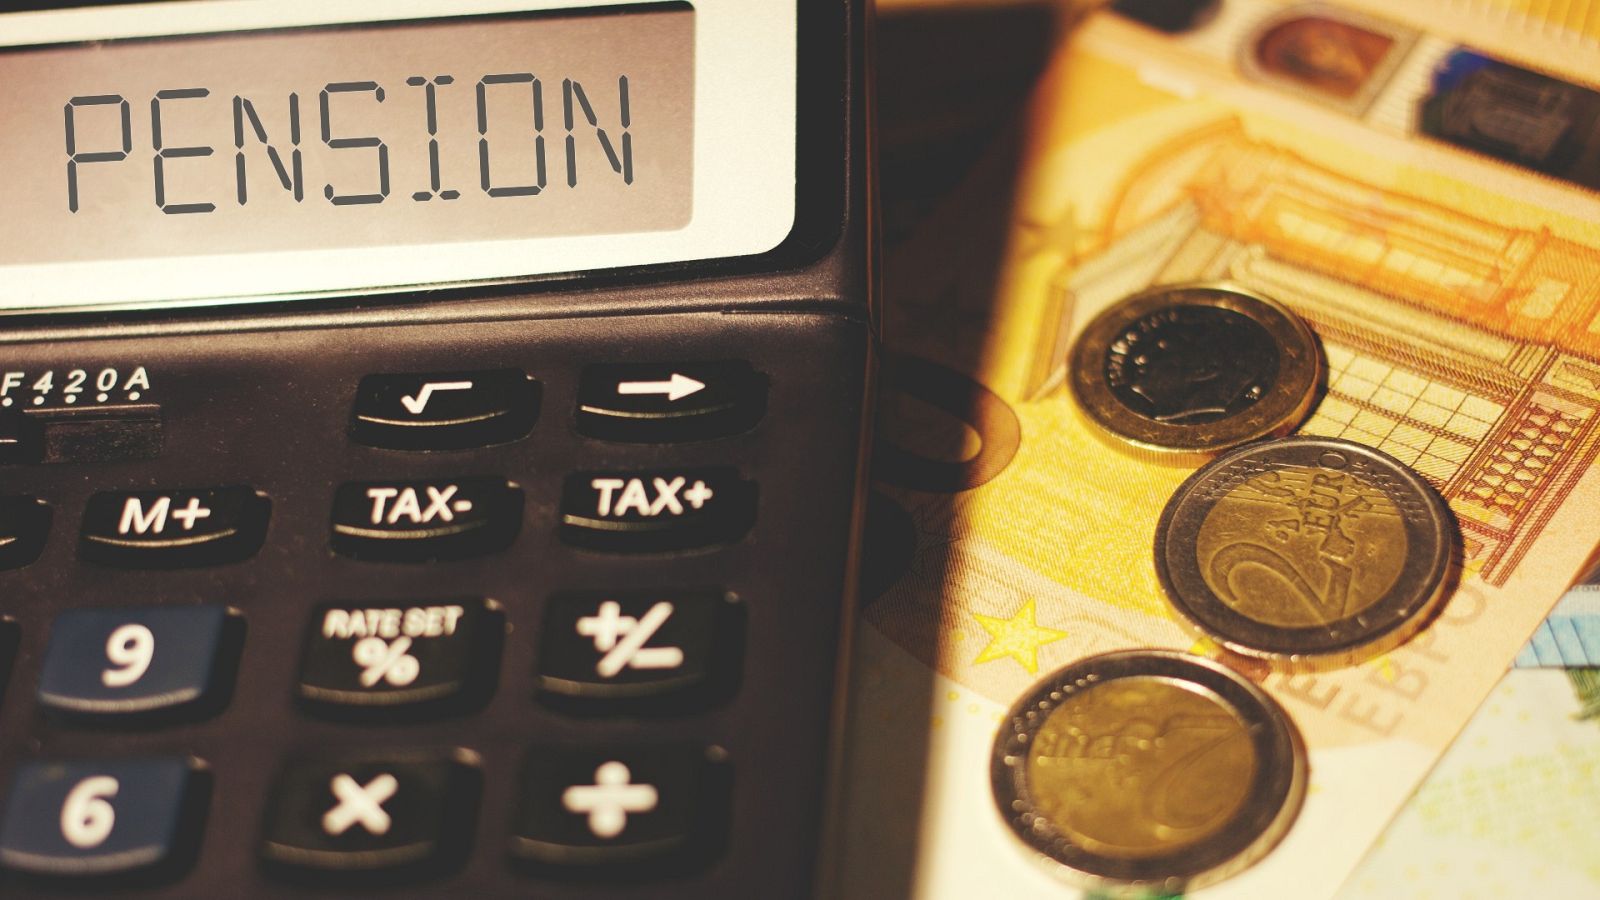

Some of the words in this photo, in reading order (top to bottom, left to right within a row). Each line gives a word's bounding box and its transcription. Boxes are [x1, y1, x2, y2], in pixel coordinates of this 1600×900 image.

[64, 73, 632, 214] PENSION
[119, 496, 211, 534] M+
[367, 485, 473, 524] TAX-
[592, 476, 713, 517] TAX+
[323, 608, 401, 639] RATE
[400, 606, 464, 638] SET
[103, 624, 155, 686] 9
[61, 776, 119, 847] 6
